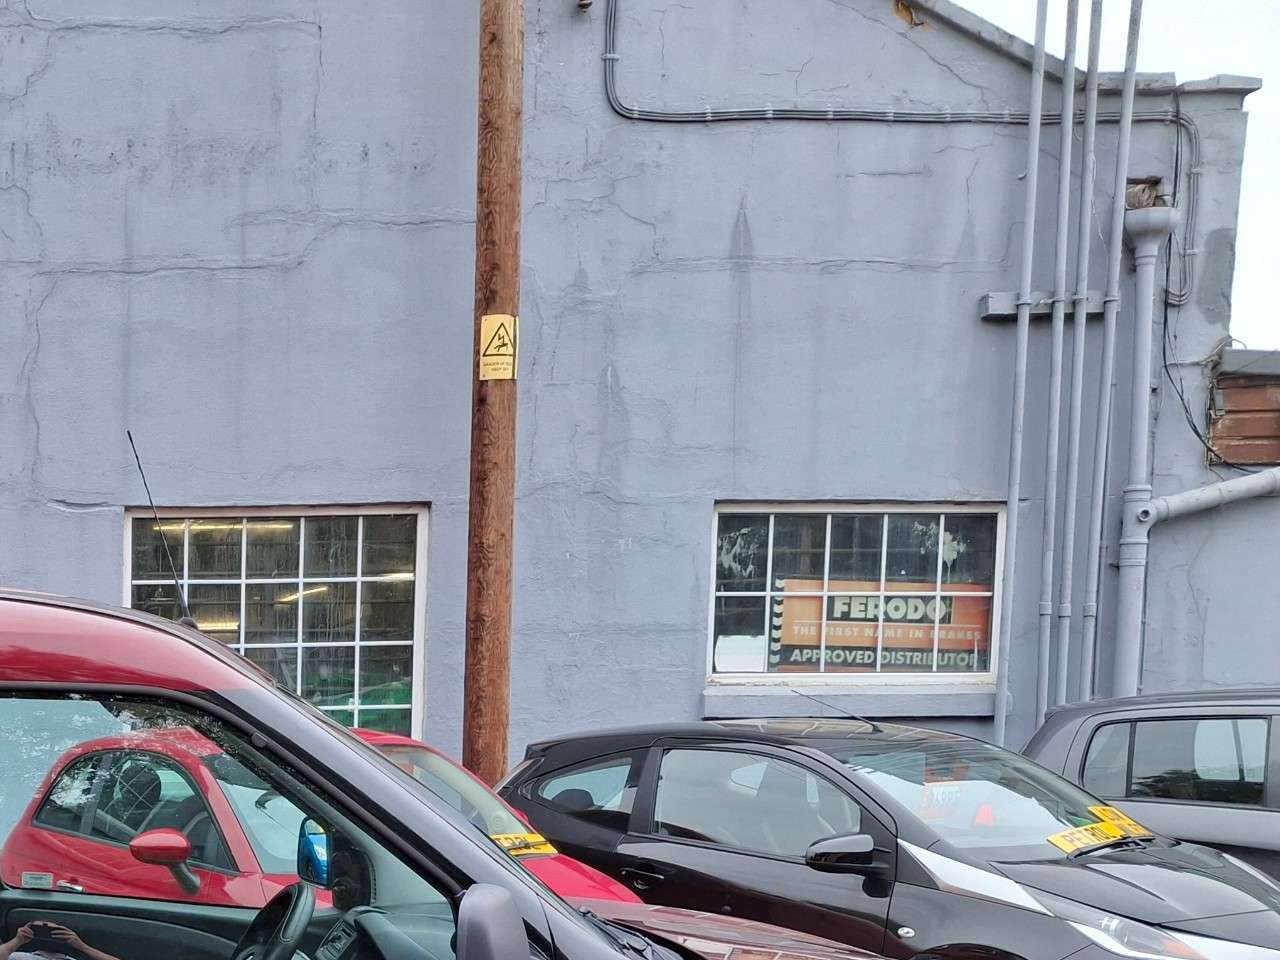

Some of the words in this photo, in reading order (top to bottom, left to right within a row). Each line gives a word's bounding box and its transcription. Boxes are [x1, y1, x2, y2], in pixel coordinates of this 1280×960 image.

[833, 596, 946, 620] FERODO
[792, 625, 817, 636] THE
[909, 629, 924, 638] IN
[790, 648, 875, 664] APPROVED
